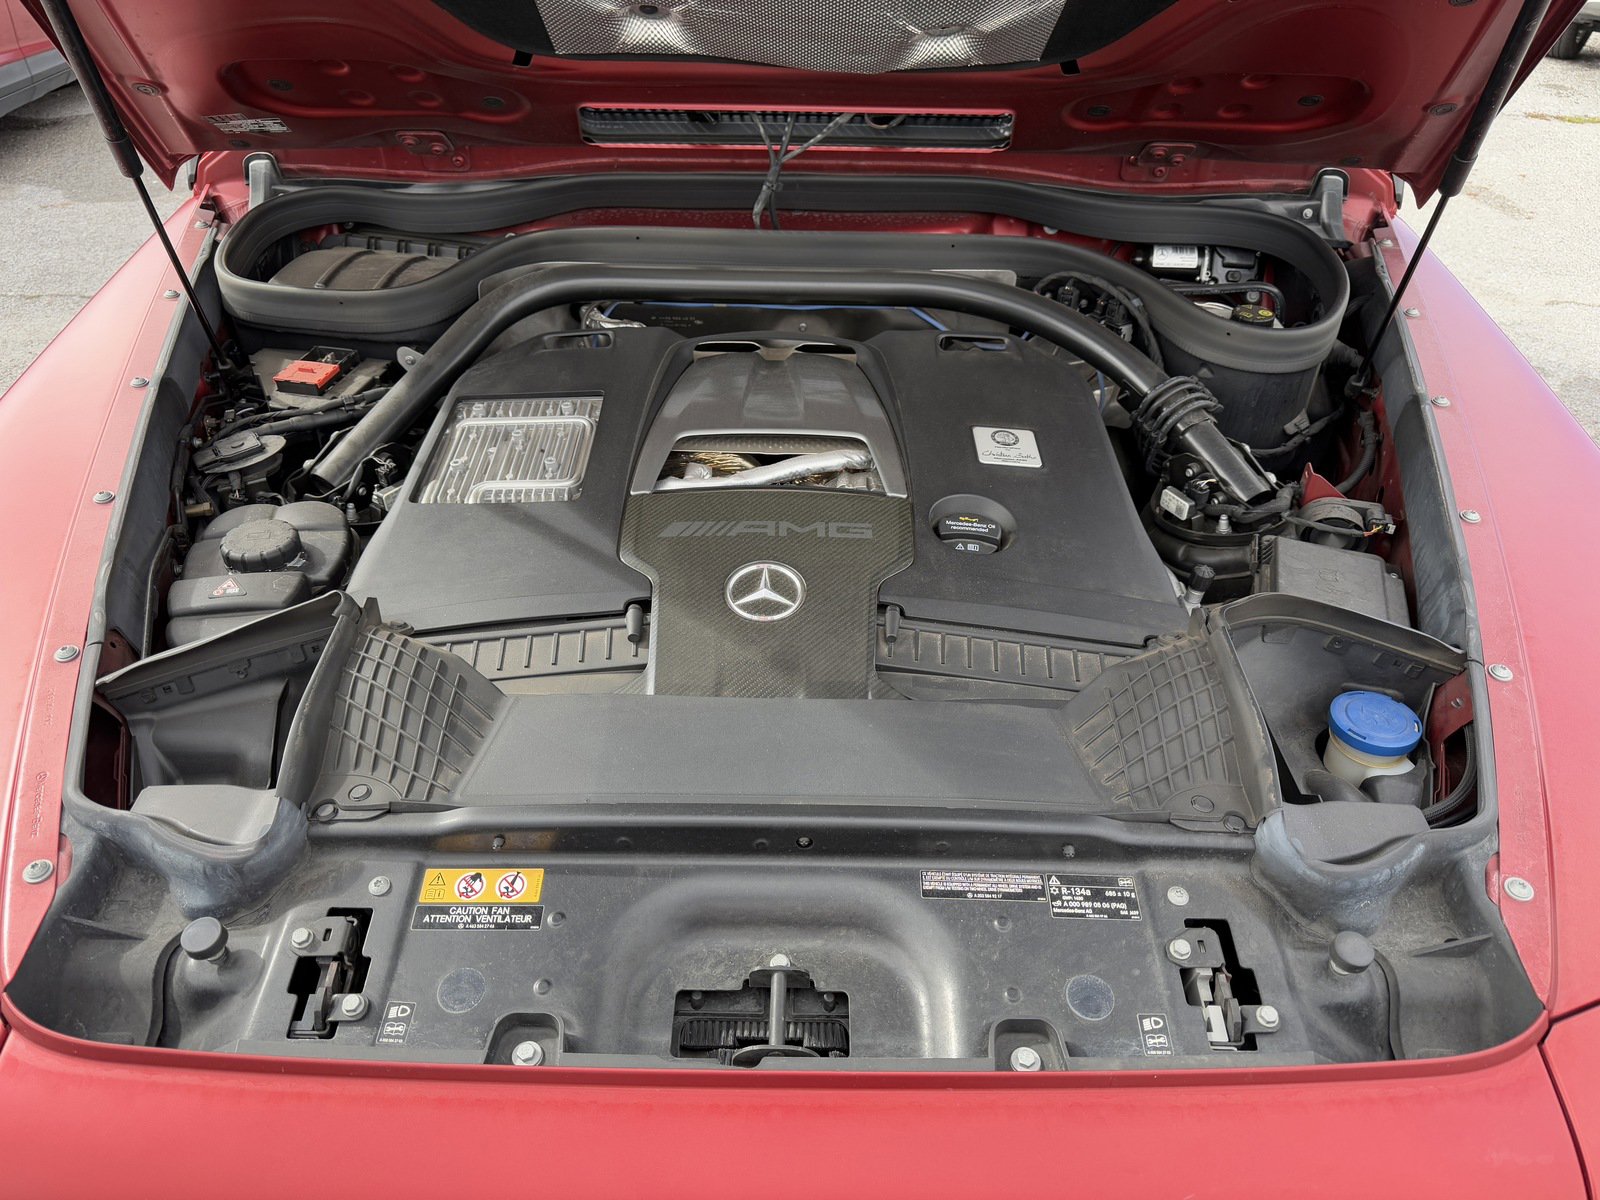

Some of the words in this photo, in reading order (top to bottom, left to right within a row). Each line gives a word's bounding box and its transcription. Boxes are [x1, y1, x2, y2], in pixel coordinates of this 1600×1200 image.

[946, 520, 987, 528] Mercedes-Benz
[728, 520, 873, 539] AMG
[950, 525, 989, 533] recommended
[1061, 887, 1091, 896] R-134a
[449, 907, 488, 915] CAUTION
[491, 907, 510, 915] FAN
[423, 914, 472, 923] ATTENTION
[476, 915, 533, 923] VENTILATEUR
